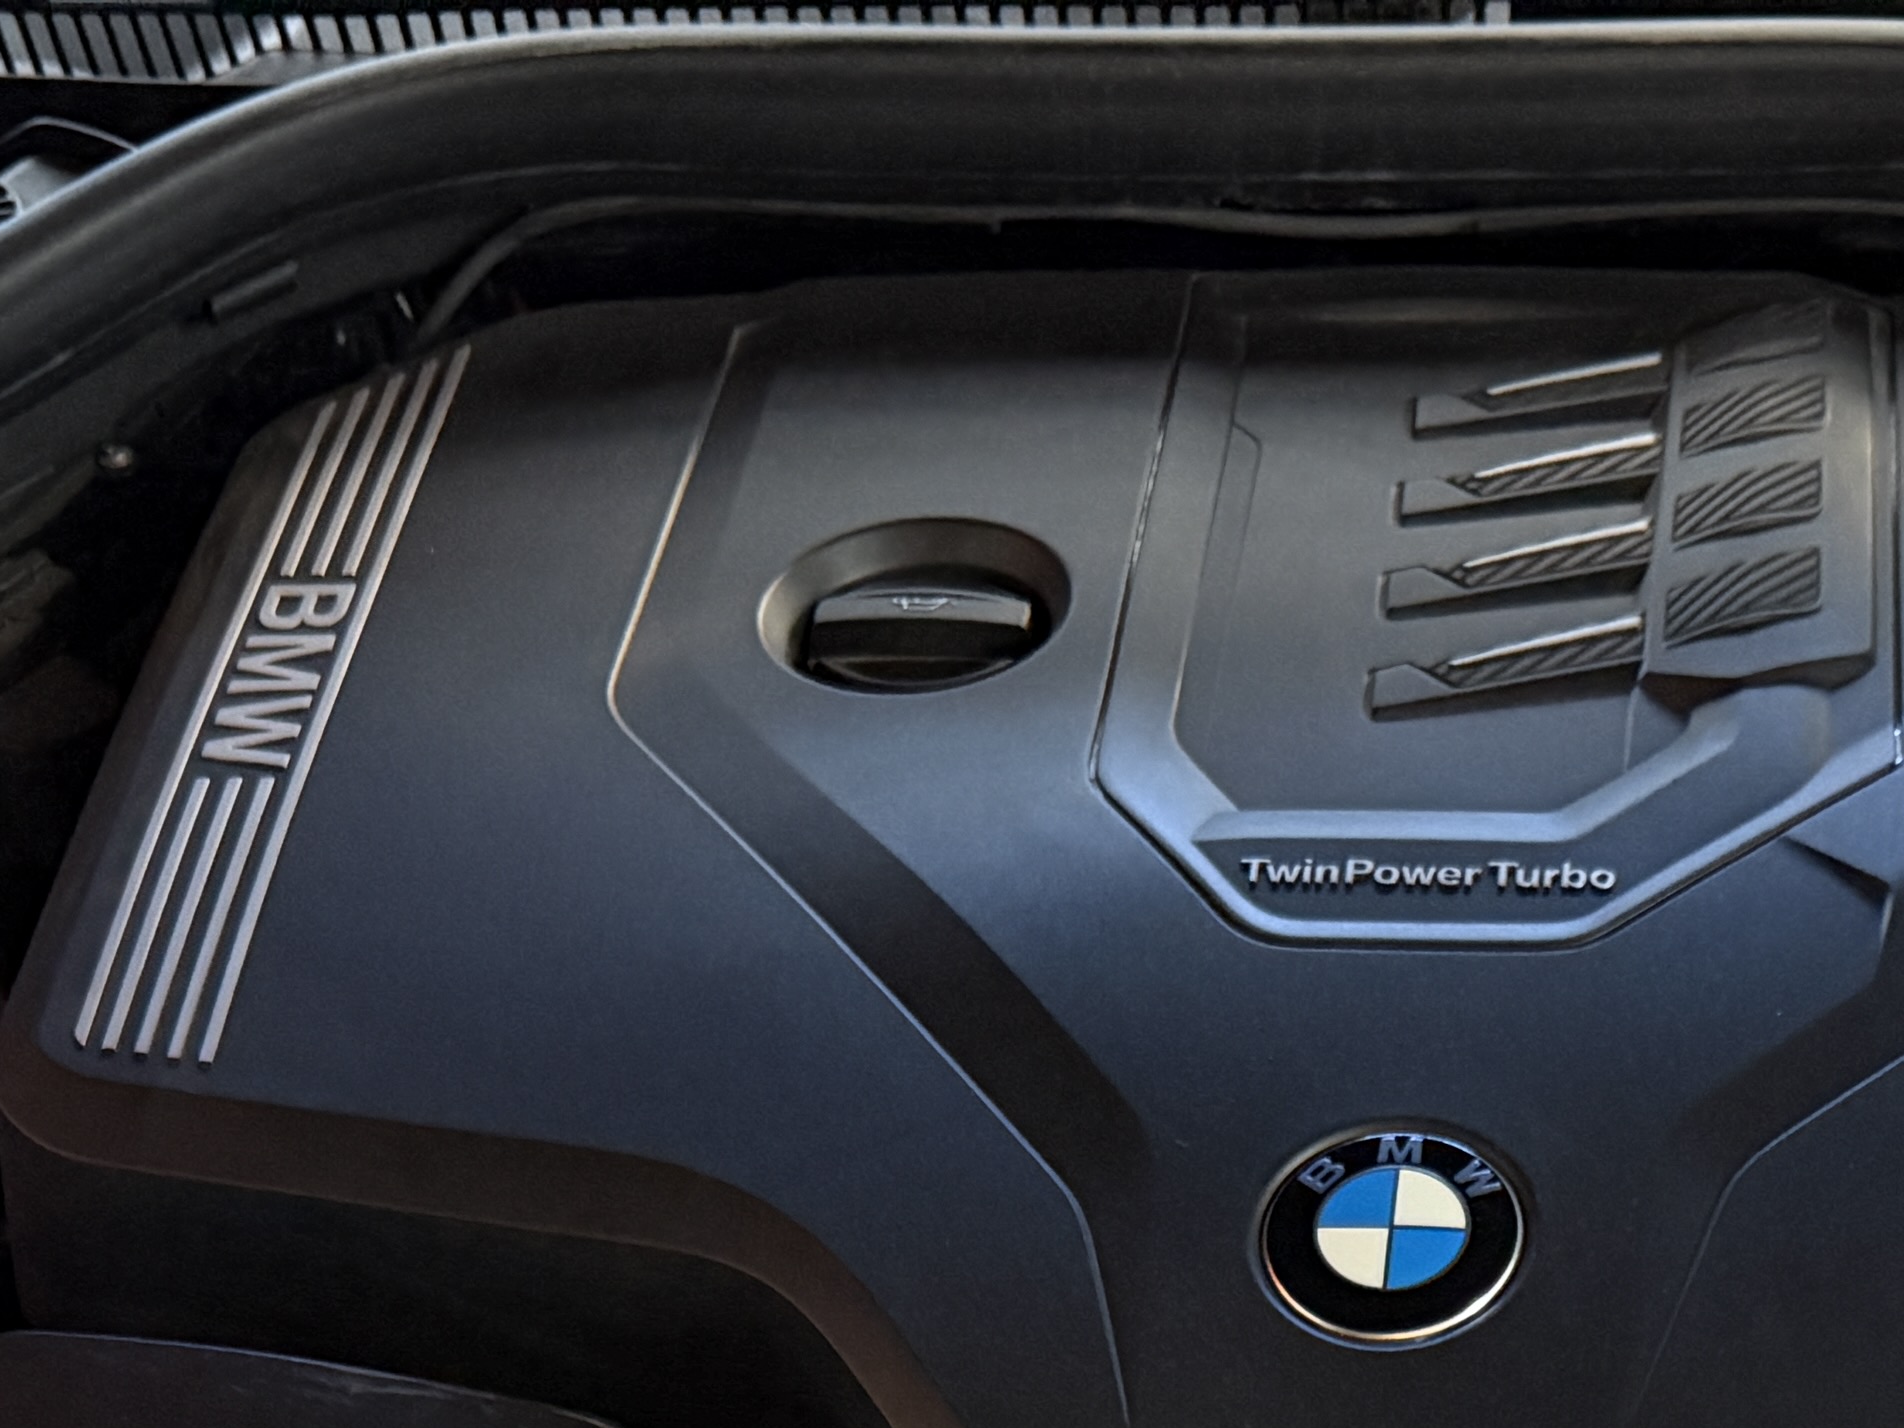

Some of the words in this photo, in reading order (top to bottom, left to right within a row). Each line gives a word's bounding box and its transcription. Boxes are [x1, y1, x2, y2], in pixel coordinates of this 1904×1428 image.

[201, 582, 357, 770] BMW
[1490, 861, 1617, 891] Turbo
[1297, 1135, 1502, 1199] BMW
